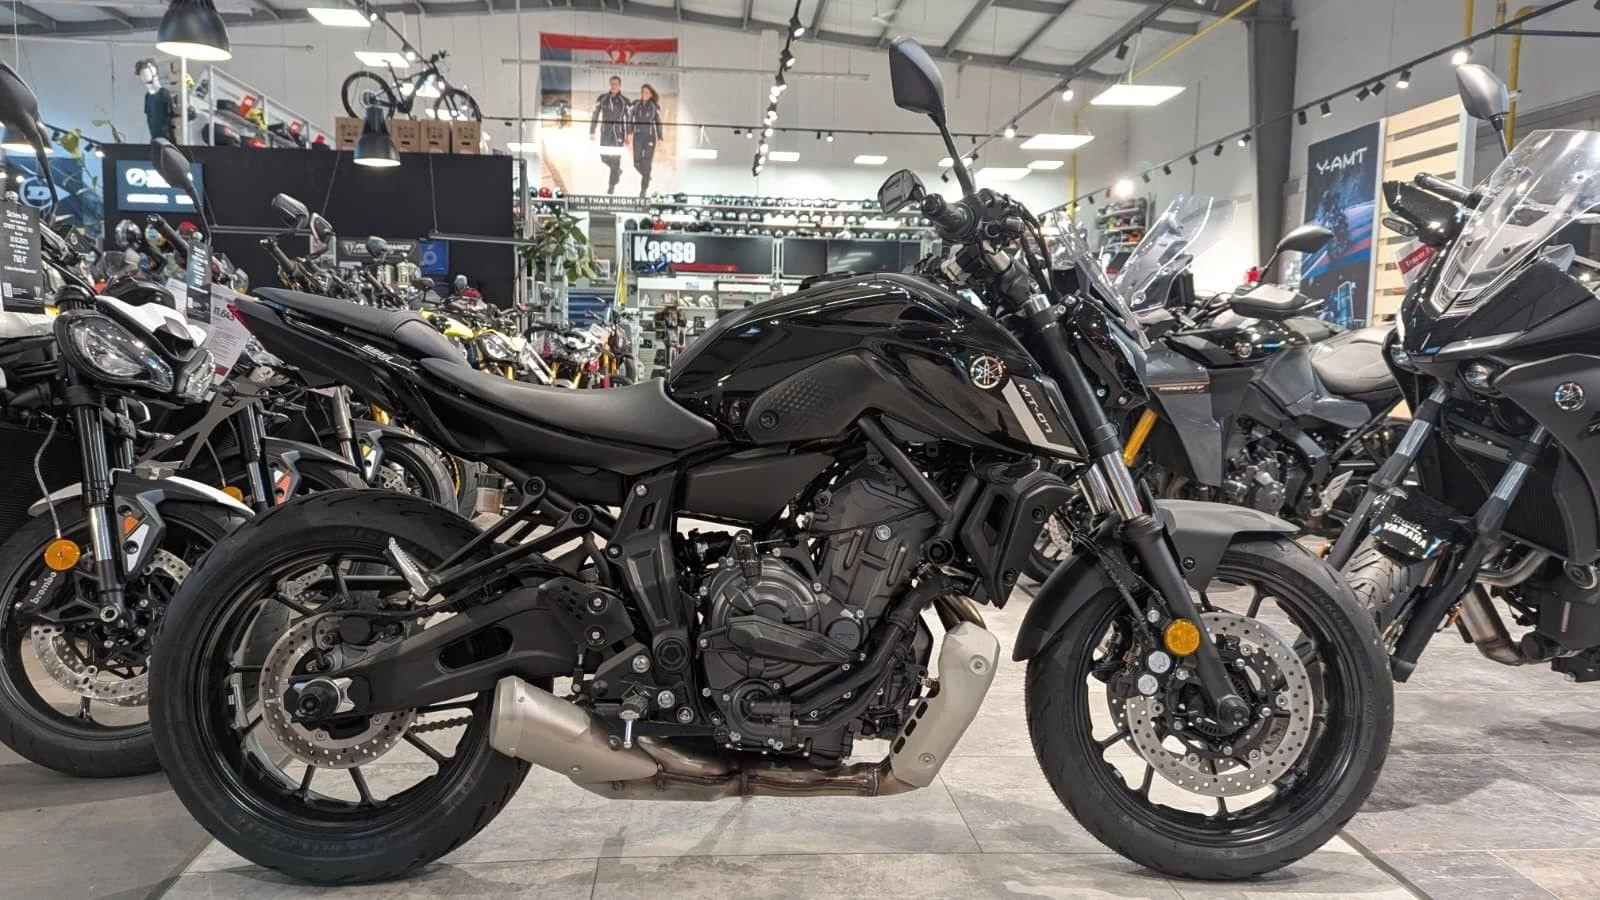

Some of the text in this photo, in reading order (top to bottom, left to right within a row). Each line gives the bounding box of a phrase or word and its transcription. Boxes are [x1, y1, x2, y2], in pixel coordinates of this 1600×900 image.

[1316, 146, 1368, 175] Y-AMT
[588, 197, 610, 205] THAN
[612, 198, 652, 206] HIGH-TEC
[634, 236, 696, 264] Kasse
[1019, 384, 1053, 433] MT-07
[1383, 521, 1427, 549] YAMAHA
[30, 571, 57, 604] brembo
